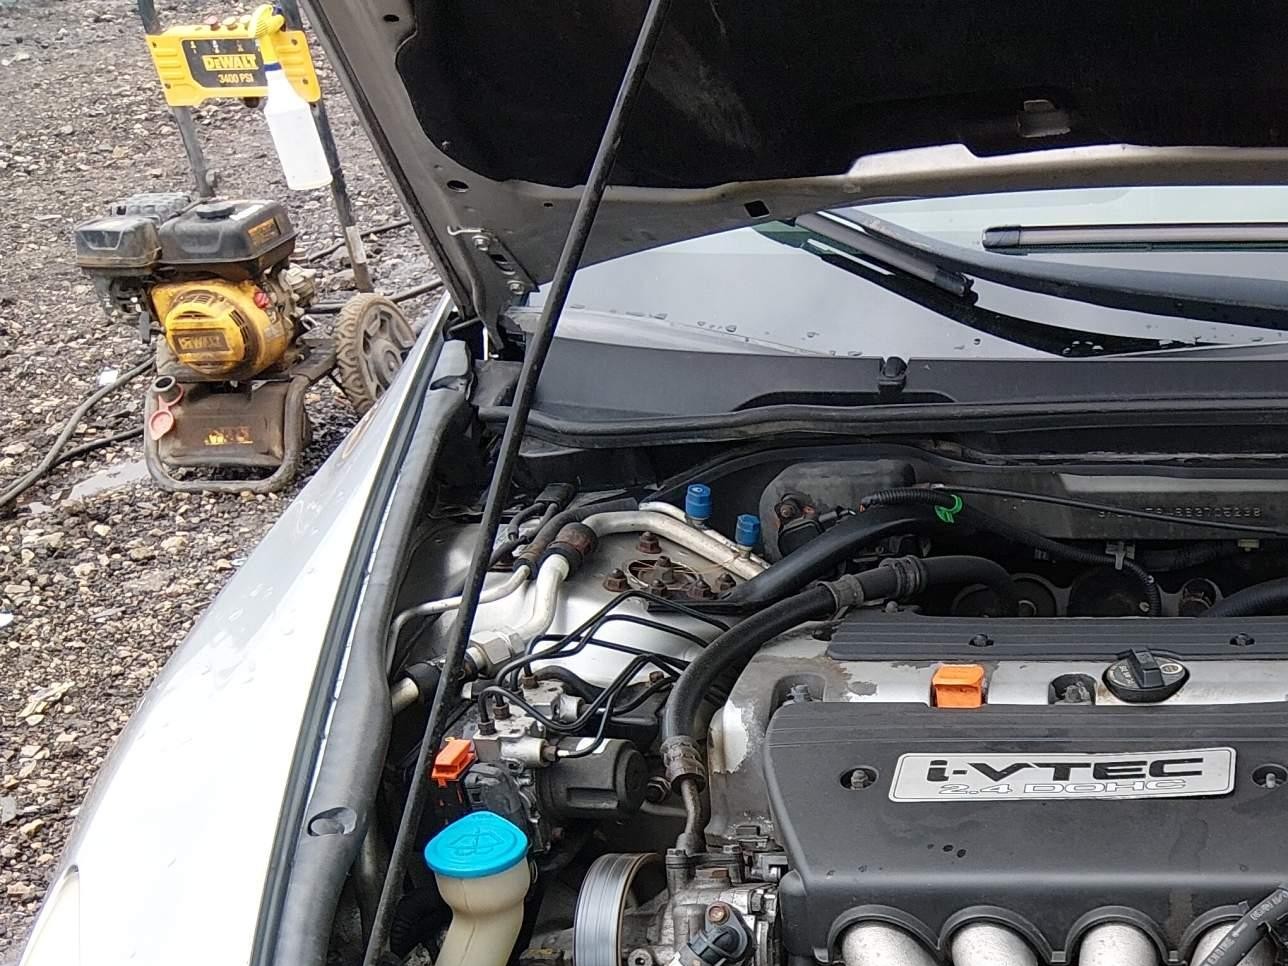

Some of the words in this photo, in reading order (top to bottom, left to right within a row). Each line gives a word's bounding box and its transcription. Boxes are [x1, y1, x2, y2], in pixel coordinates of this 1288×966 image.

[217, 73, 240, 84] 3400
[240, 73, 255, 82] PSI
[926, 757, 1204, 782] i-VTEC
[938, 783, 1013, 795] 2.4
[1023, 779, 1186, 794] DOHC
